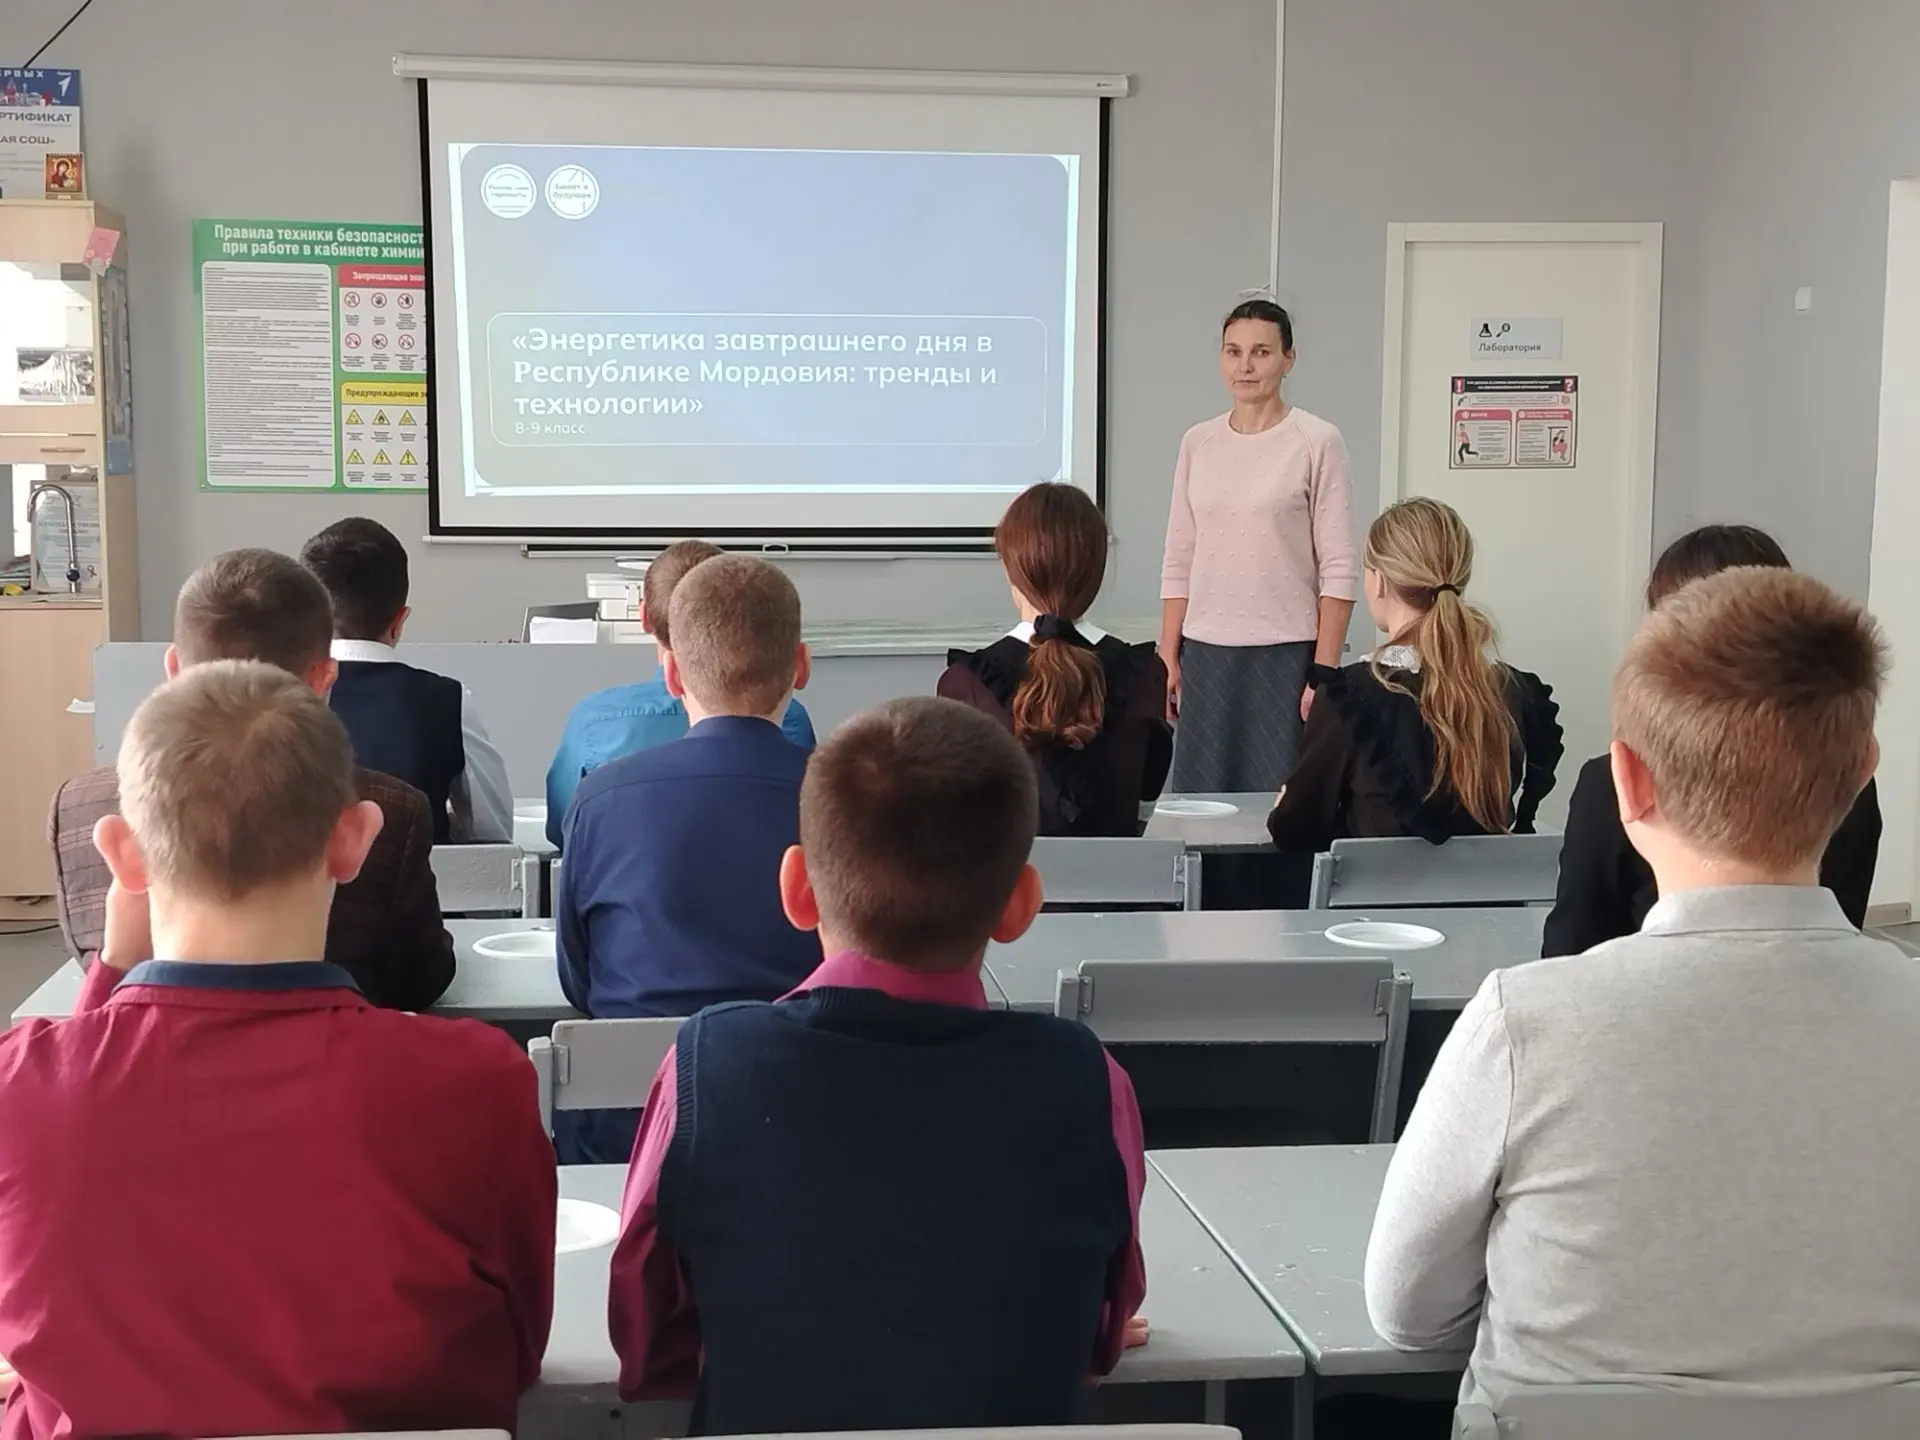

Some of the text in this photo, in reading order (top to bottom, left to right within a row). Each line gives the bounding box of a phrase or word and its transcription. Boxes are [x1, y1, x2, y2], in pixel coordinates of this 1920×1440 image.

[0, 70, 44, 78] РВЫХ
[214, 224, 274, 241] Правила
[277, 228, 333, 241] техники
[223, 241, 248, 256] при
[251, 241, 300, 256] работе
[303, 244, 311, 255] в
[314, 242, 378, 257] кабинете
[512, 327, 993, 357] «Энергетика завтрашнего дня в
[1478, 342, 1542, 354] Лаборатория
[513, 359, 997, 389] Республике Мордовия: тренды и
[514, 396, 704, 415] технологии»
[515, 422, 587, 435] 8-9 класс
